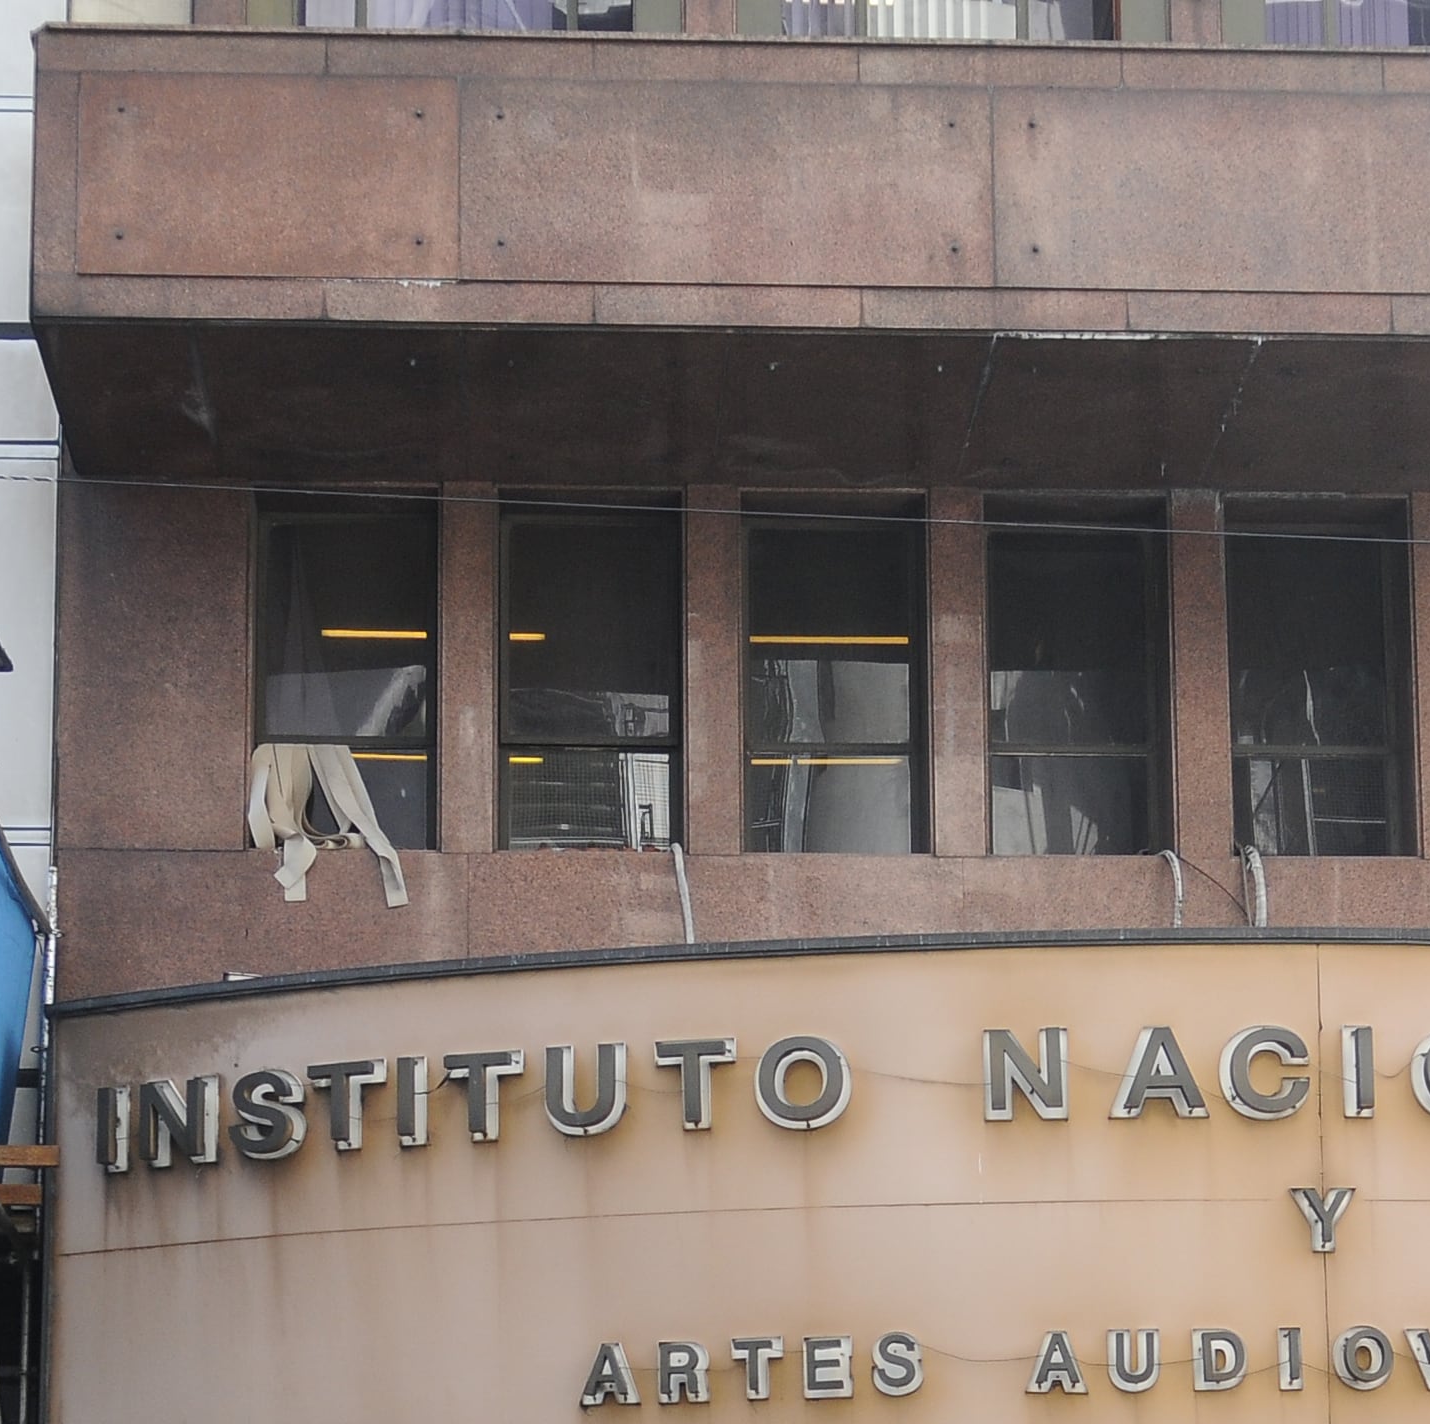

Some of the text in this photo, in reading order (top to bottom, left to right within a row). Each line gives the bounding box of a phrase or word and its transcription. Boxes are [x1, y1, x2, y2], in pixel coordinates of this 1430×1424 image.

[96, 1034, 853, 1175] INSTITUTO
[1289, 1186, 1357, 1254] Y
[579, 1330, 925, 1408] ARTES
